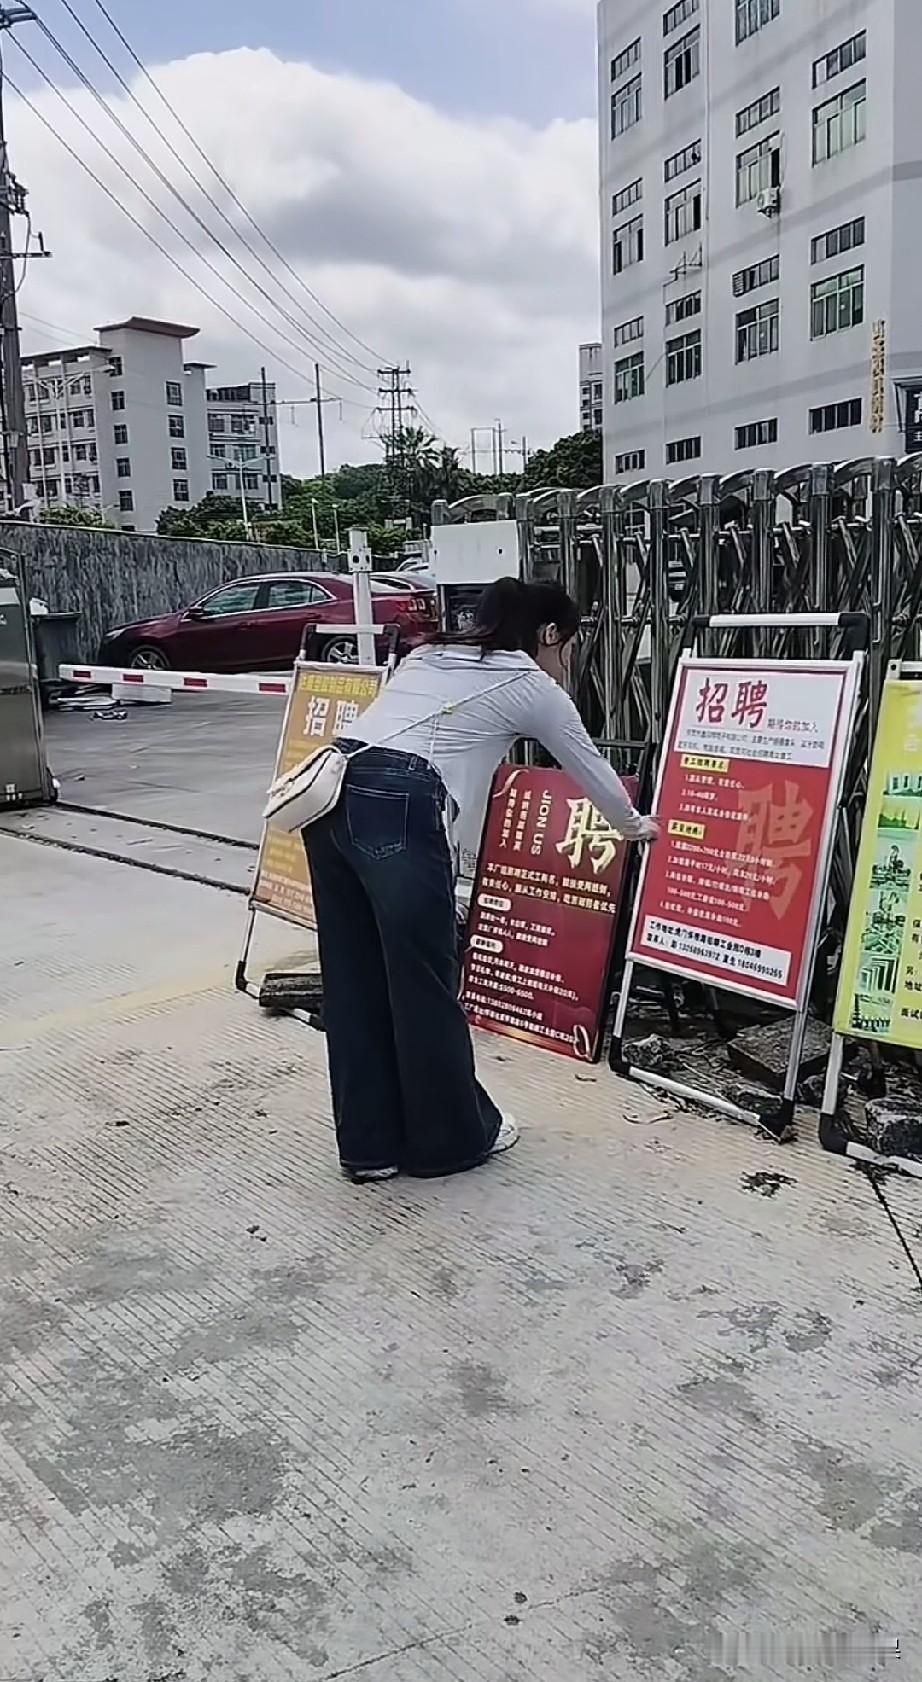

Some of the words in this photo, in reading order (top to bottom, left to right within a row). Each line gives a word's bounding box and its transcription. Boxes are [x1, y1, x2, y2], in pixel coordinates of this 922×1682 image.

[696, 677, 768, 728] 招聘
[536, 790, 552, 828] JION
[531, 833, 545, 855] US
[556, 797, 624, 876] 聘
